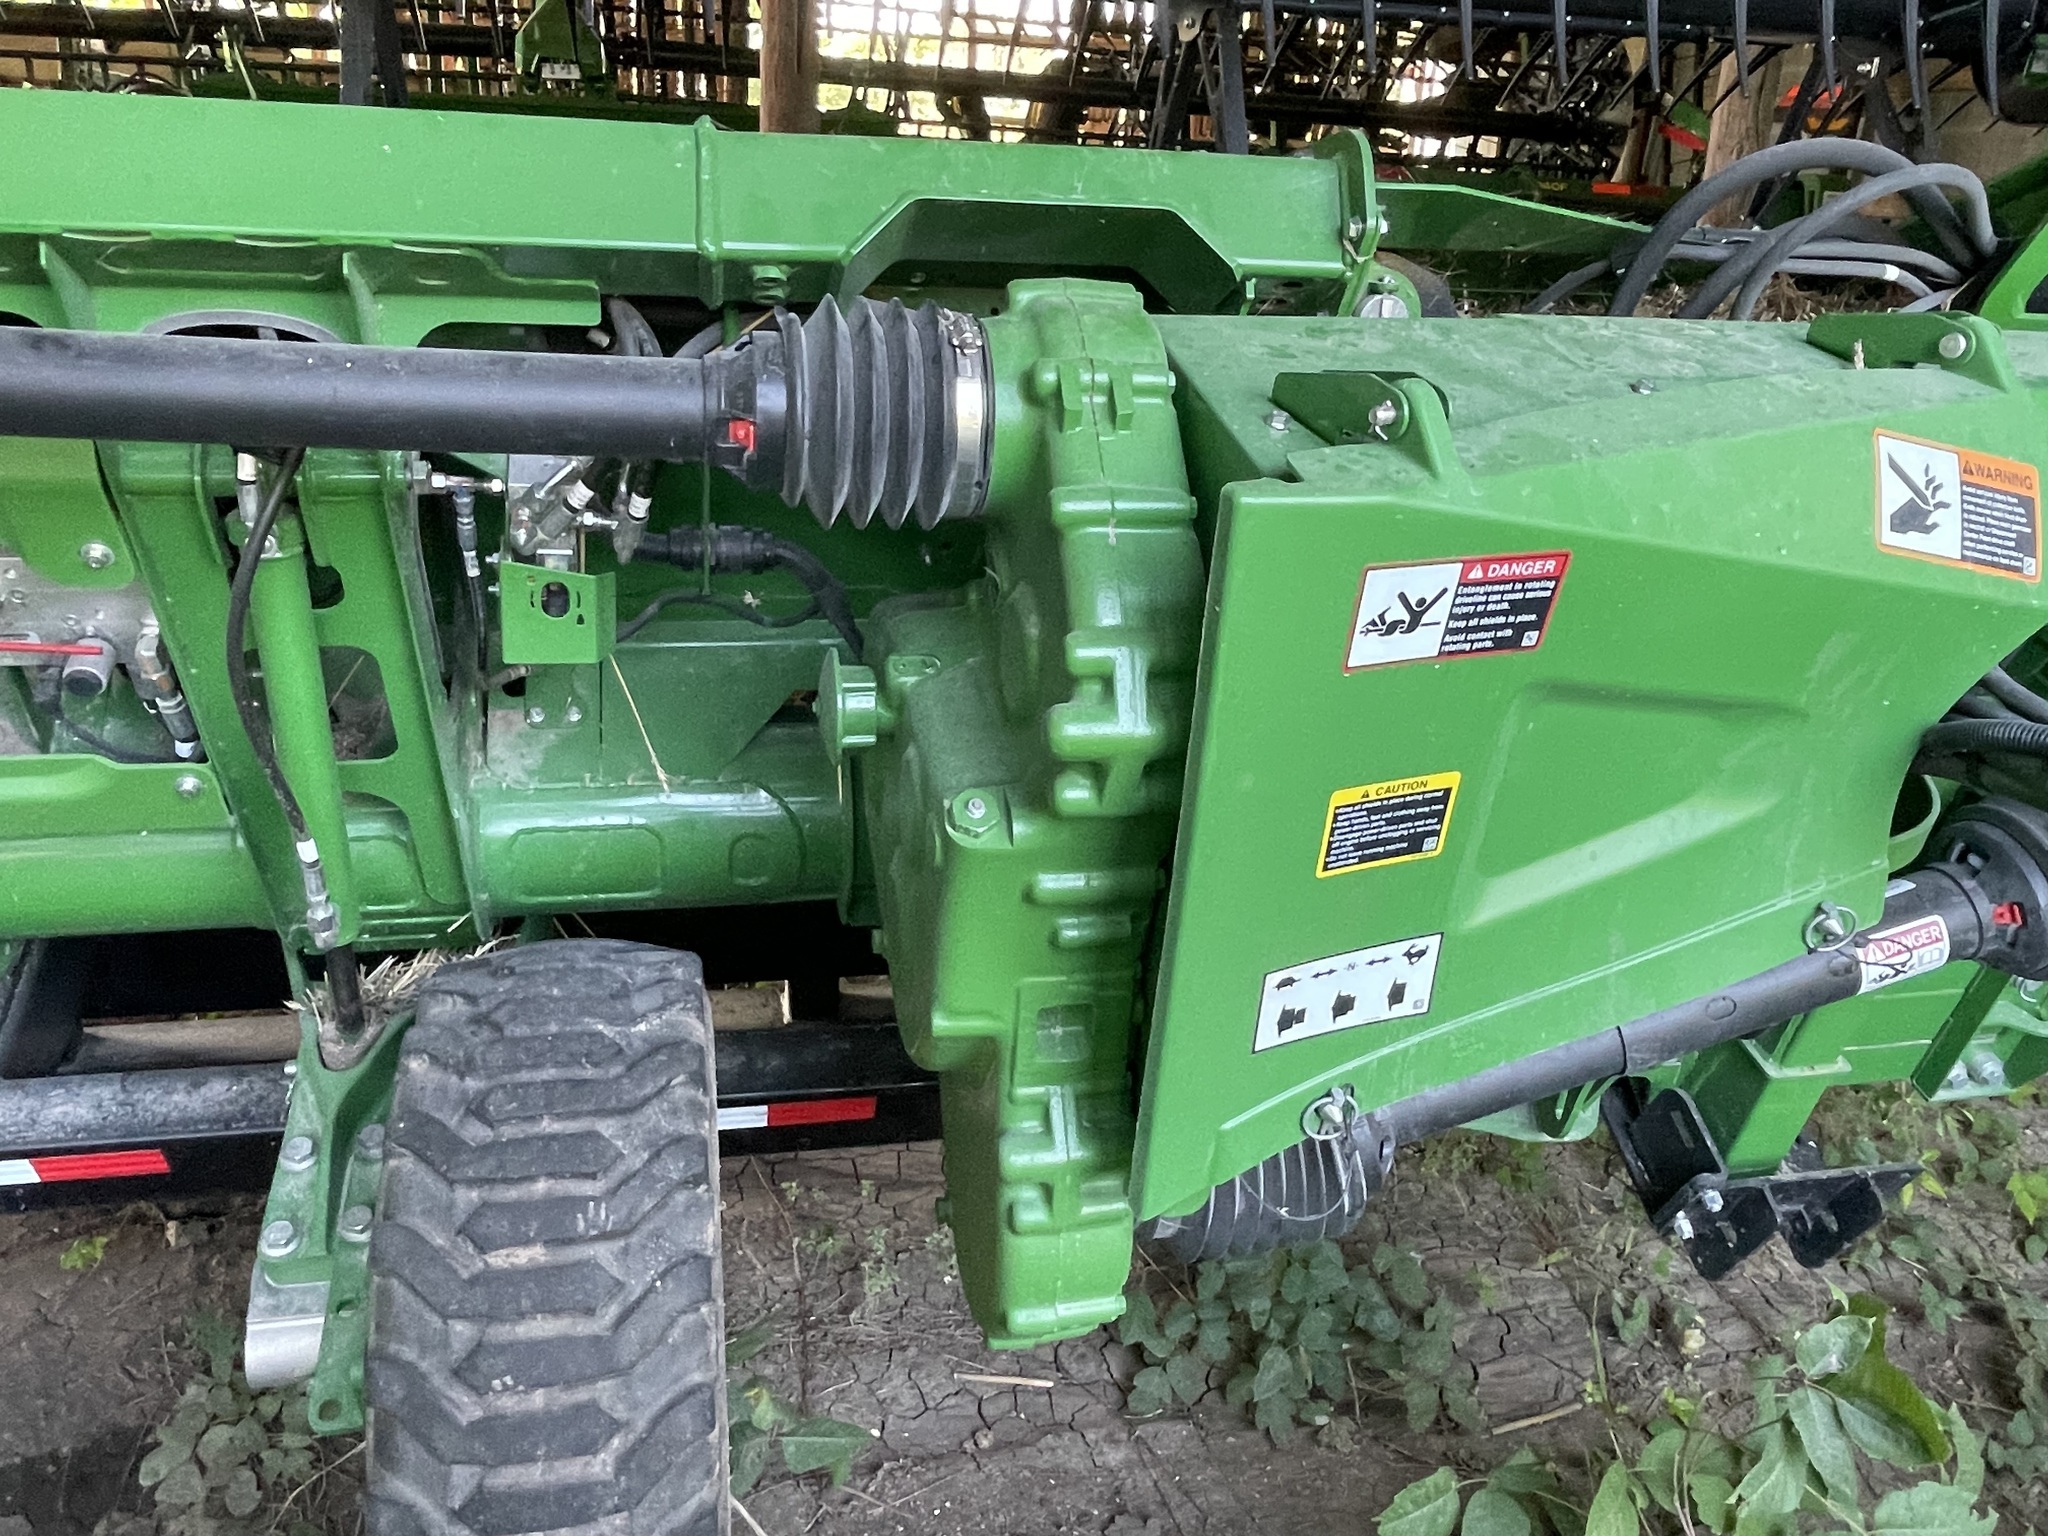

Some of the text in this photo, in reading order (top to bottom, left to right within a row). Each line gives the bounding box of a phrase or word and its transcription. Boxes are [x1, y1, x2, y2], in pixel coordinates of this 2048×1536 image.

[1974, 462, 2033, 490] WARNING
[1487, 559, 1556, 578] DANGER
[1457, 580, 1556, 594] Entanglement in rotating
[1487, 593, 1501, 601] can
[1502, 592, 1524, 600] cause
[1452, 605, 1475, 615] injury
[1476, 604, 1486, 612] or
[1448, 619, 1467, 629] Keep
[1468, 618, 1479, 627] all
[1479, 616, 1506, 626] shields
[1507, 615, 1515, 623] in
[1443, 629, 1513, 643] Avoid contact with
[1441, 642, 1471, 652] rotating
[1375, 780, 1428, 797] CAUTION
[1882, 925, 1942, 957] DANGER
